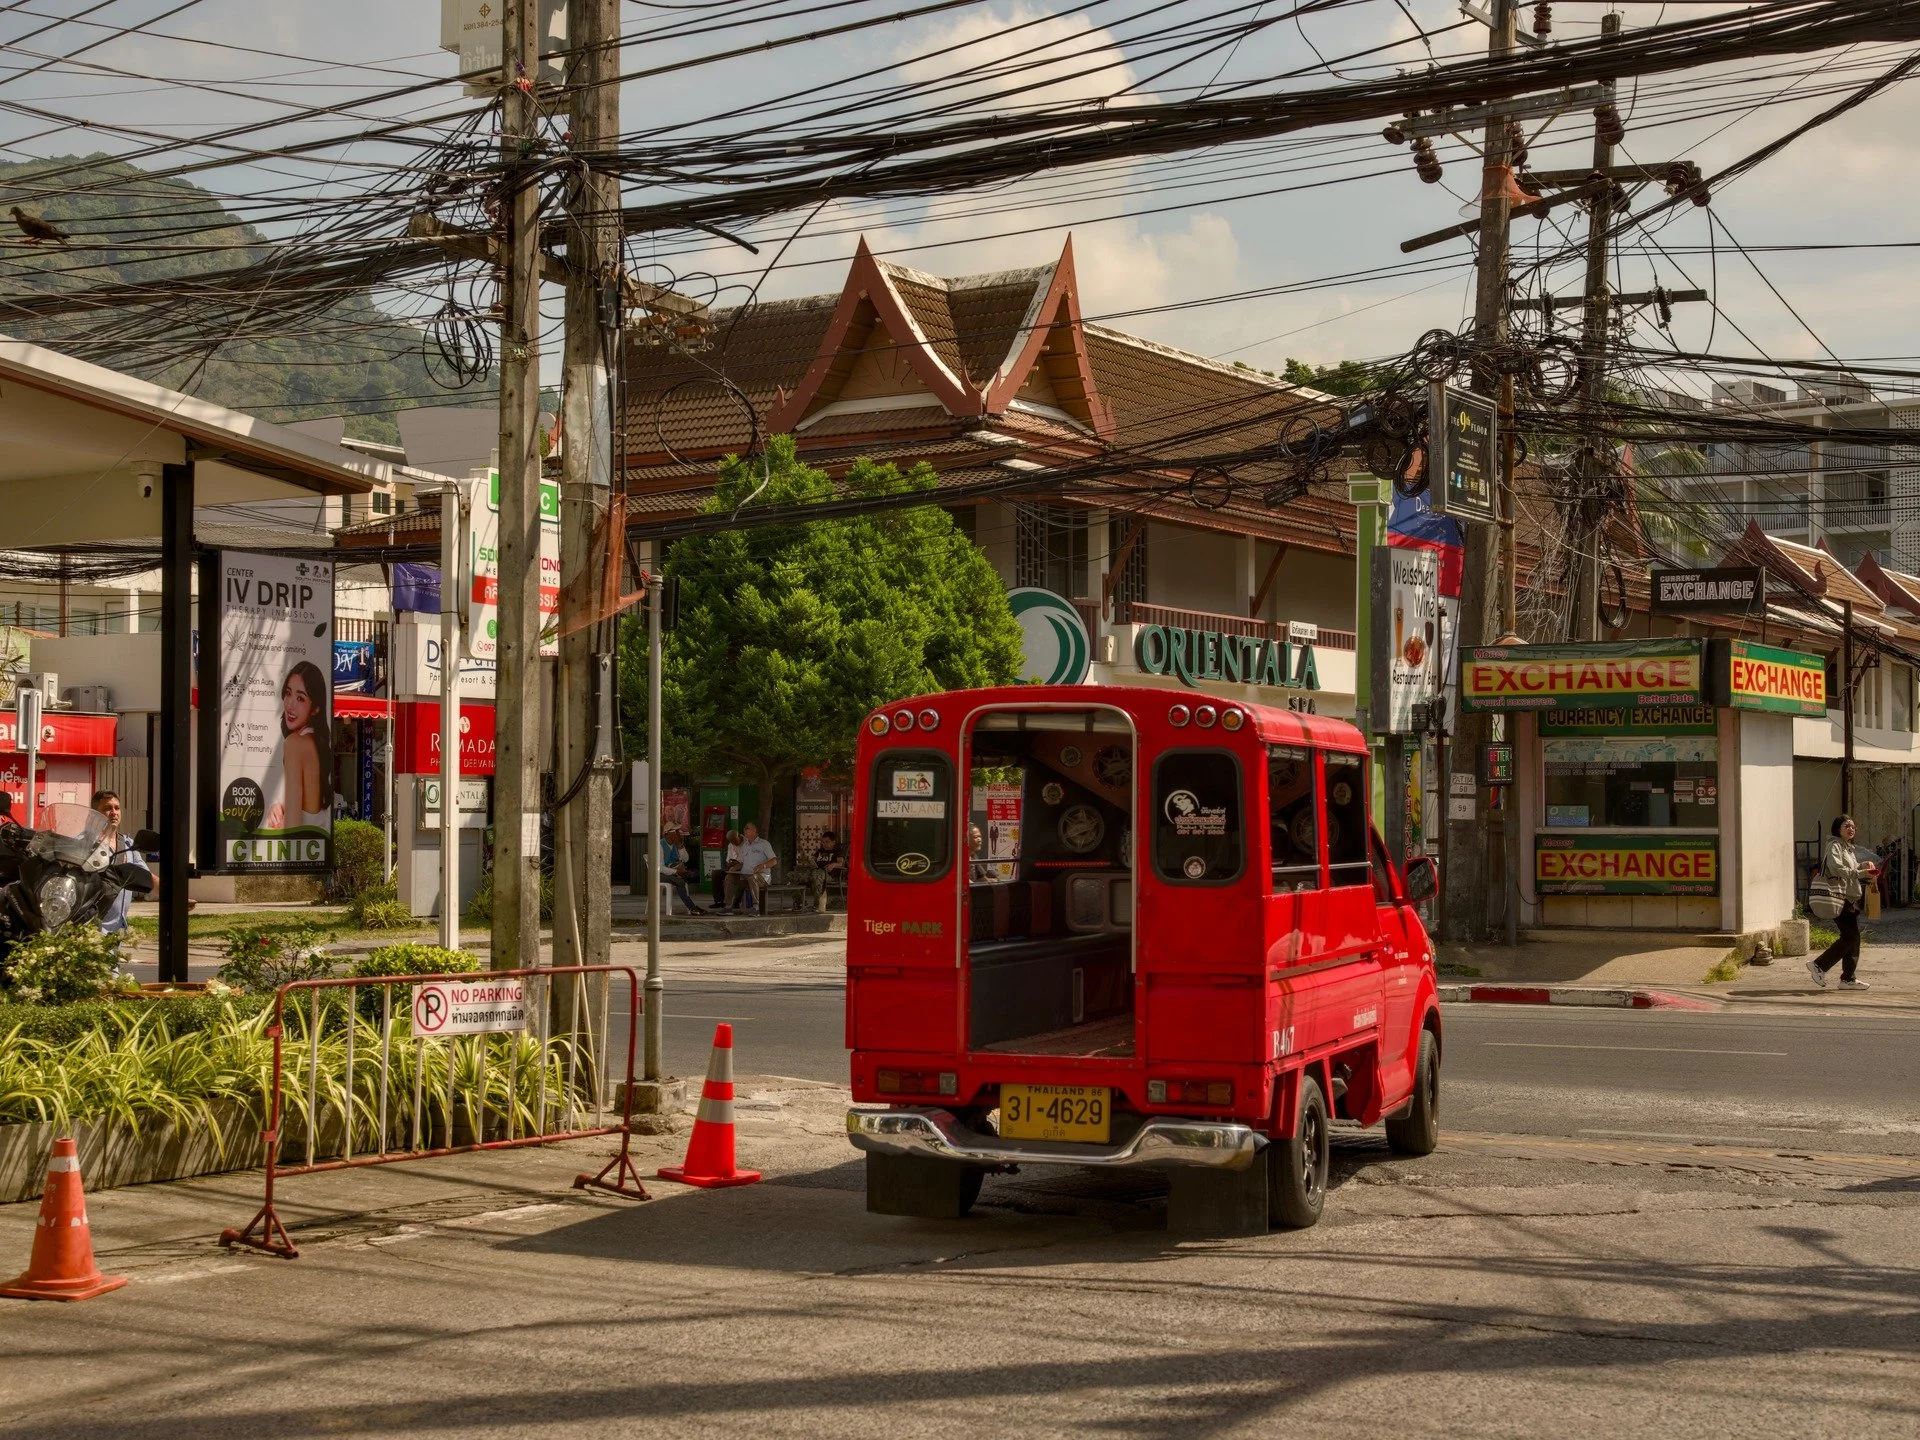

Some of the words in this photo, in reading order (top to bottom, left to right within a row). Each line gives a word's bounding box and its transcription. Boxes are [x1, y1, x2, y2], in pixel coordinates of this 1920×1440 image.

[1470, 423, 1488, 436] FLOOR
[227, 567, 254, 578] CENTER
[226, 578, 250, 604] IV
[258, 580, 313, 610] DRIP
[1660, 581, 1754, 601] EXCHANGE
[226, 604, 267, 615] THERAPY
[271, 610, 315, 620] INFUSION
[249, 632, 276, 641] Hangover
[1136, 623, 1322, 690] ORIENTALA
[1473, 649, 1509, 660] Money
[1473, 660, 1691, 692] EXCHANGE
[1733, 660, 1823, 700] EXCHANGE
[248, 690, 276, 698] Hydration
[1638, 694, 1669, 704] Better
[1670, 693, 1694, 703] Rate
[1288, 697, 1316, 715] SPA
[1546, 709, 1626, 726] CURRENCY
[1631, 707, 1715, 726] EXCHANGE
[247, 723, 268, 731] Vitamin
[247, 734, 263, 742] Boost
[232, 787, 256, 796] BOOK
[235, 797, 255, 806] NOW
[232, 840, 320, 861] CLINIC
[1542, 838, 1575, 848] Money
[1540, 852, 1712, 879] EXCHANGE
[863, 919, 896, 935] Tiger
[902, 921, 942, 934] PARK
[451, 988, 470, 1003] NO
[473, 985, 523, 1002] PARKING
[1027, 1086, 1084, 1096] THAILAND
[1007, 1096, 1103, 1126] 31-4629
